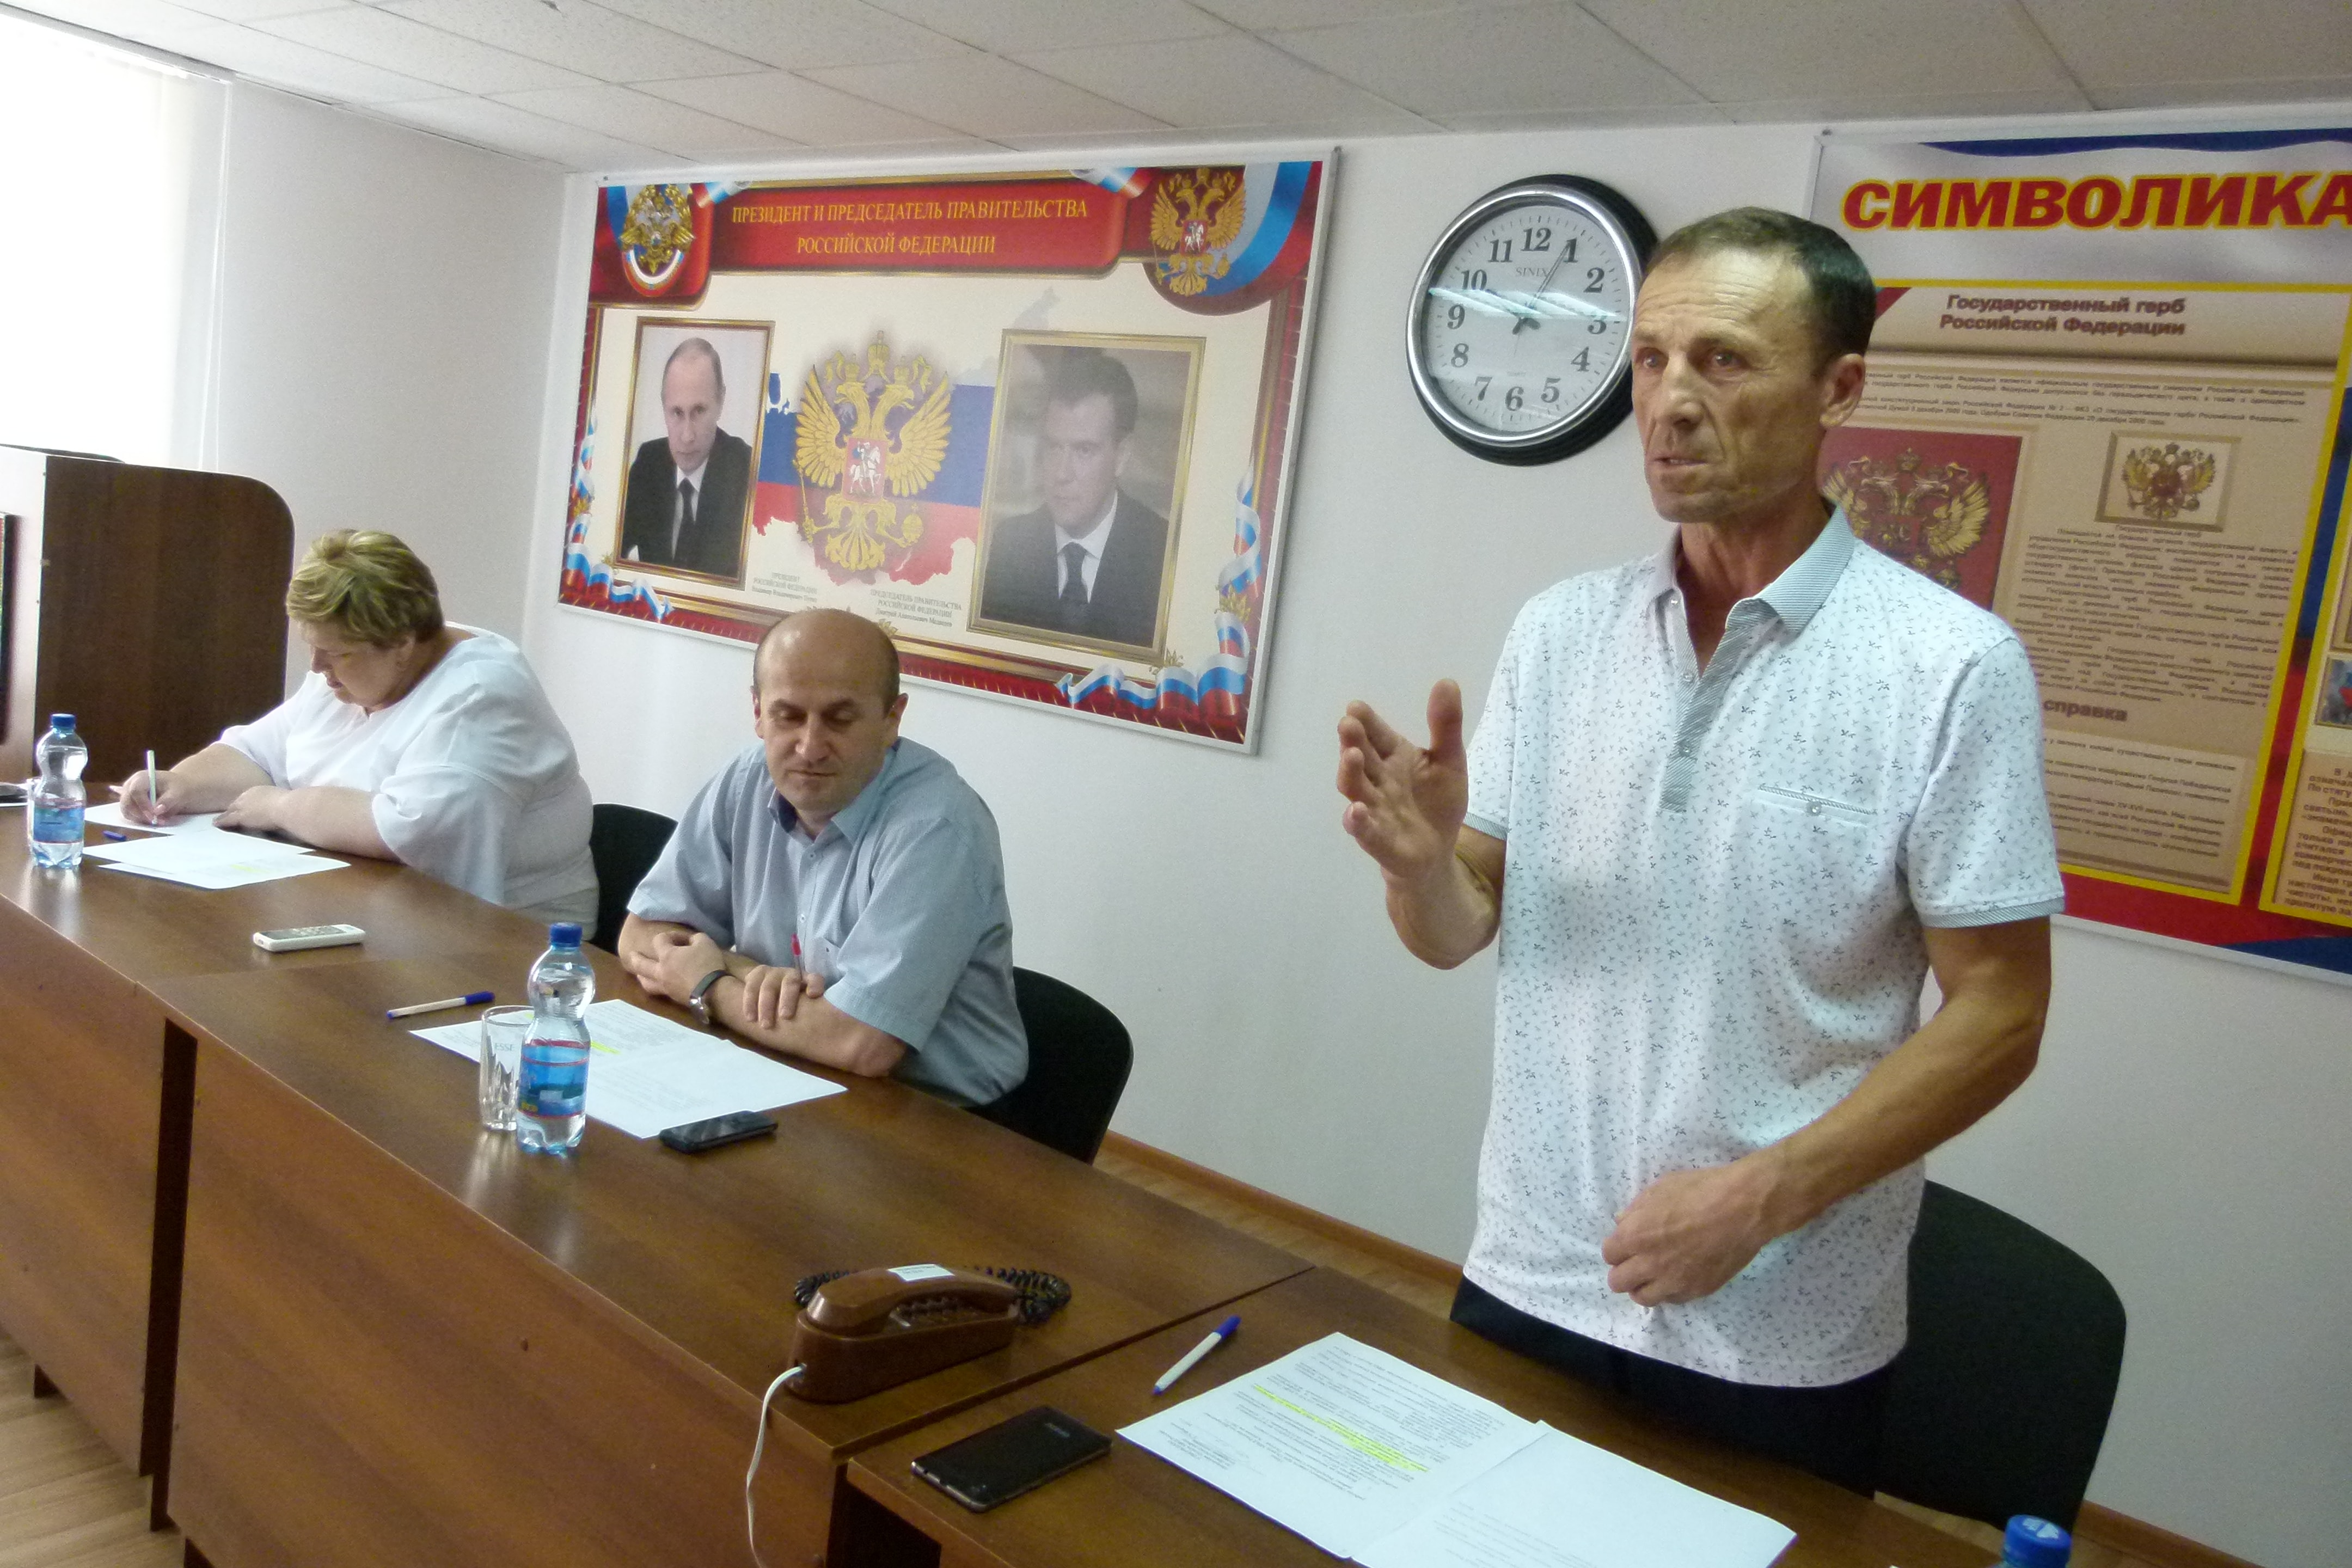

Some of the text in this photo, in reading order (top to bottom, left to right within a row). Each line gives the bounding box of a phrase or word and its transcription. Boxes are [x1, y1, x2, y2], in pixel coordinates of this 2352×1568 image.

[732, 199, 1088, 224] ПРЕЗИДЕНТ И ПРЕДСЕДАТЕЛЬ ПРАВИТЕЛЬСТВА
[1843, 173, 2352, 230] СИМВОЛИКА
[797, 232, 996, 256] РОССИЙСКОЙ ФЕДЕРАЦИИ
[1488, 239, 1513, 263] 11
[1521, 228, 1551, 252] 12
[1563, 238, 1578, 263] 1
[1461, 270, 1487, 291] 10
[1583, 267, 1605, 293] 2
[1447, 304, 1465, 329] 9
[1946, 294, 2186, 317] Государственный герб
[1587, 313, 1607, 335] 3
[1940, 314, 2186, 336] Российской Федерации
[1450, 343, 1469, 367] 8
[1571, 346, 1590, 372] 4
[1474, 376, 1493, 401] 7
[1505, 386, 1523, 411] 6
[1540, 378, 1561, 403] 5
[2043, 700, 2128, 721] справка
